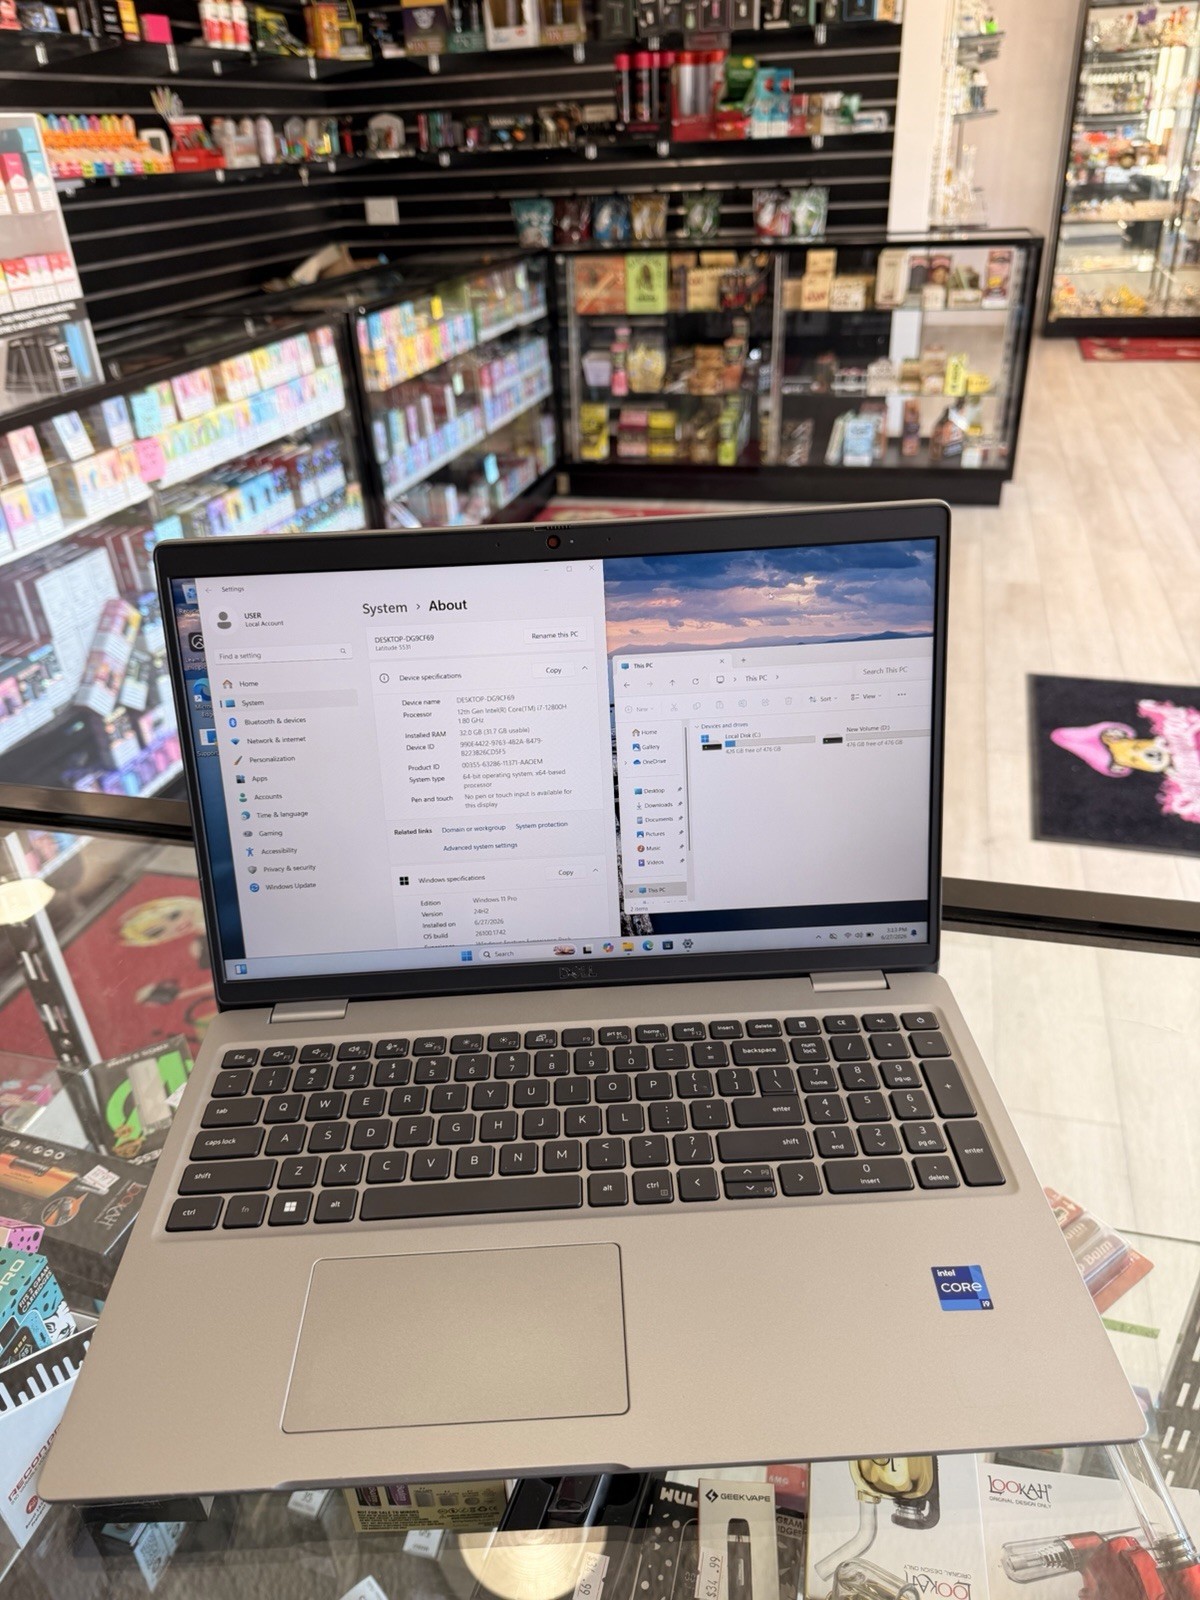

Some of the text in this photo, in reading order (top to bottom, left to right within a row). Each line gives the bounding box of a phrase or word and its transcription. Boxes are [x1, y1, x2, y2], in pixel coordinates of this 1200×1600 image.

[221, 585, 245, 593] Settings
[362, 600, 468, 617] System About
[245, 620, 261, 628] Local
[375, 634, 435, 644] DESKTOP-DG9CF69
[531, 632, 556, 640] Rename
[558, 631, 567, 639] this
[375, 644, 397, 652] Latitude
[219, 652, 233, 661] Find
[239, 651, 262, 660] setting
[545, 666, 562, 675] Copy
[862, 665, 908, 676] Search This PC
[421, 672, 462, 681] specifications
[241, 699, 264, 708] System
[402, 698, 422, 706] Device
[403, 710, 432, 719] Processor
[470, 707, 483, 715] Gen
[508, 705, 536, 714] Core(TM)
[244, 716, 307, 726] Bluetooth & devices
[405, 731, 430, 739] Installed
[498, 727, 508, 735] GB
[247, 735, 306, 745] Network & internet
[249, 755, 296, 763] Personalization
[408, 764, 431, 772] Product
[252, 775, 268, 783] Apps
[644, 787, 665, 795] Desktop
[280, 810, 309, 819] language
[441, 826, 465, 834] Domain
[474, 824, 506, 833] workgroup
[515, 820, 569, 831] System protection
[258, 830, 283, 838] Gaming
[394, 827, 433, 836] Related links
[261, 847, 297, 855] Accessibility
[443, 841, 518, 852] Advanced system settings
[263, 866, 285, 874] Privacy
[293, 864, 316, 872] security
[558, 868, 574, 877] Copy
[418, 874, 486, 884] Windows specifications
[265, 883, 294, 891] Windows
[420, 899, 441, 907] Edition
[472, 896, 499, 904] Windows
[421, 910, 443, 918] Version
[422, 921, 447, 929] Installed
[433, 932, 449, 940] build
[494, 950, 515, 958] Search
[742, 1046, 777, 1055] backspace
[362, 1097, 370, 1106] E
[403, 1094, 412, 1103] R
[279, 1102, 288, 1112] Q
[319, 1099, 332, 1109] W
[216, 1107, 228, 1115] tab
[772, 1105, 791, 1113] enter
[579, 1115, 587, 1124] K
[324, 1130, 332, 1140] S
[366, 1128, 375, 1138] D
[204, 1137, 236, 1147] caps lock
[280, 1133, 289, 1143] A
[782, 1137, 800, 1146] shift
[556, 1150, 568, 1160] M
[194, 1171, 211, 1180] shift
[928, 1173, 950, 1182] delete
[859, 1177, 880, 1185] insert
[602, 1184, 613, 1192] alt
[182, 1208, 196, 1217] ctrl
[936, 1269, 956, 1277] intel
[987, 1474, 1053, 1504] LOOKAH
[720, 1493, 771, 1503] GEEKVAPE
